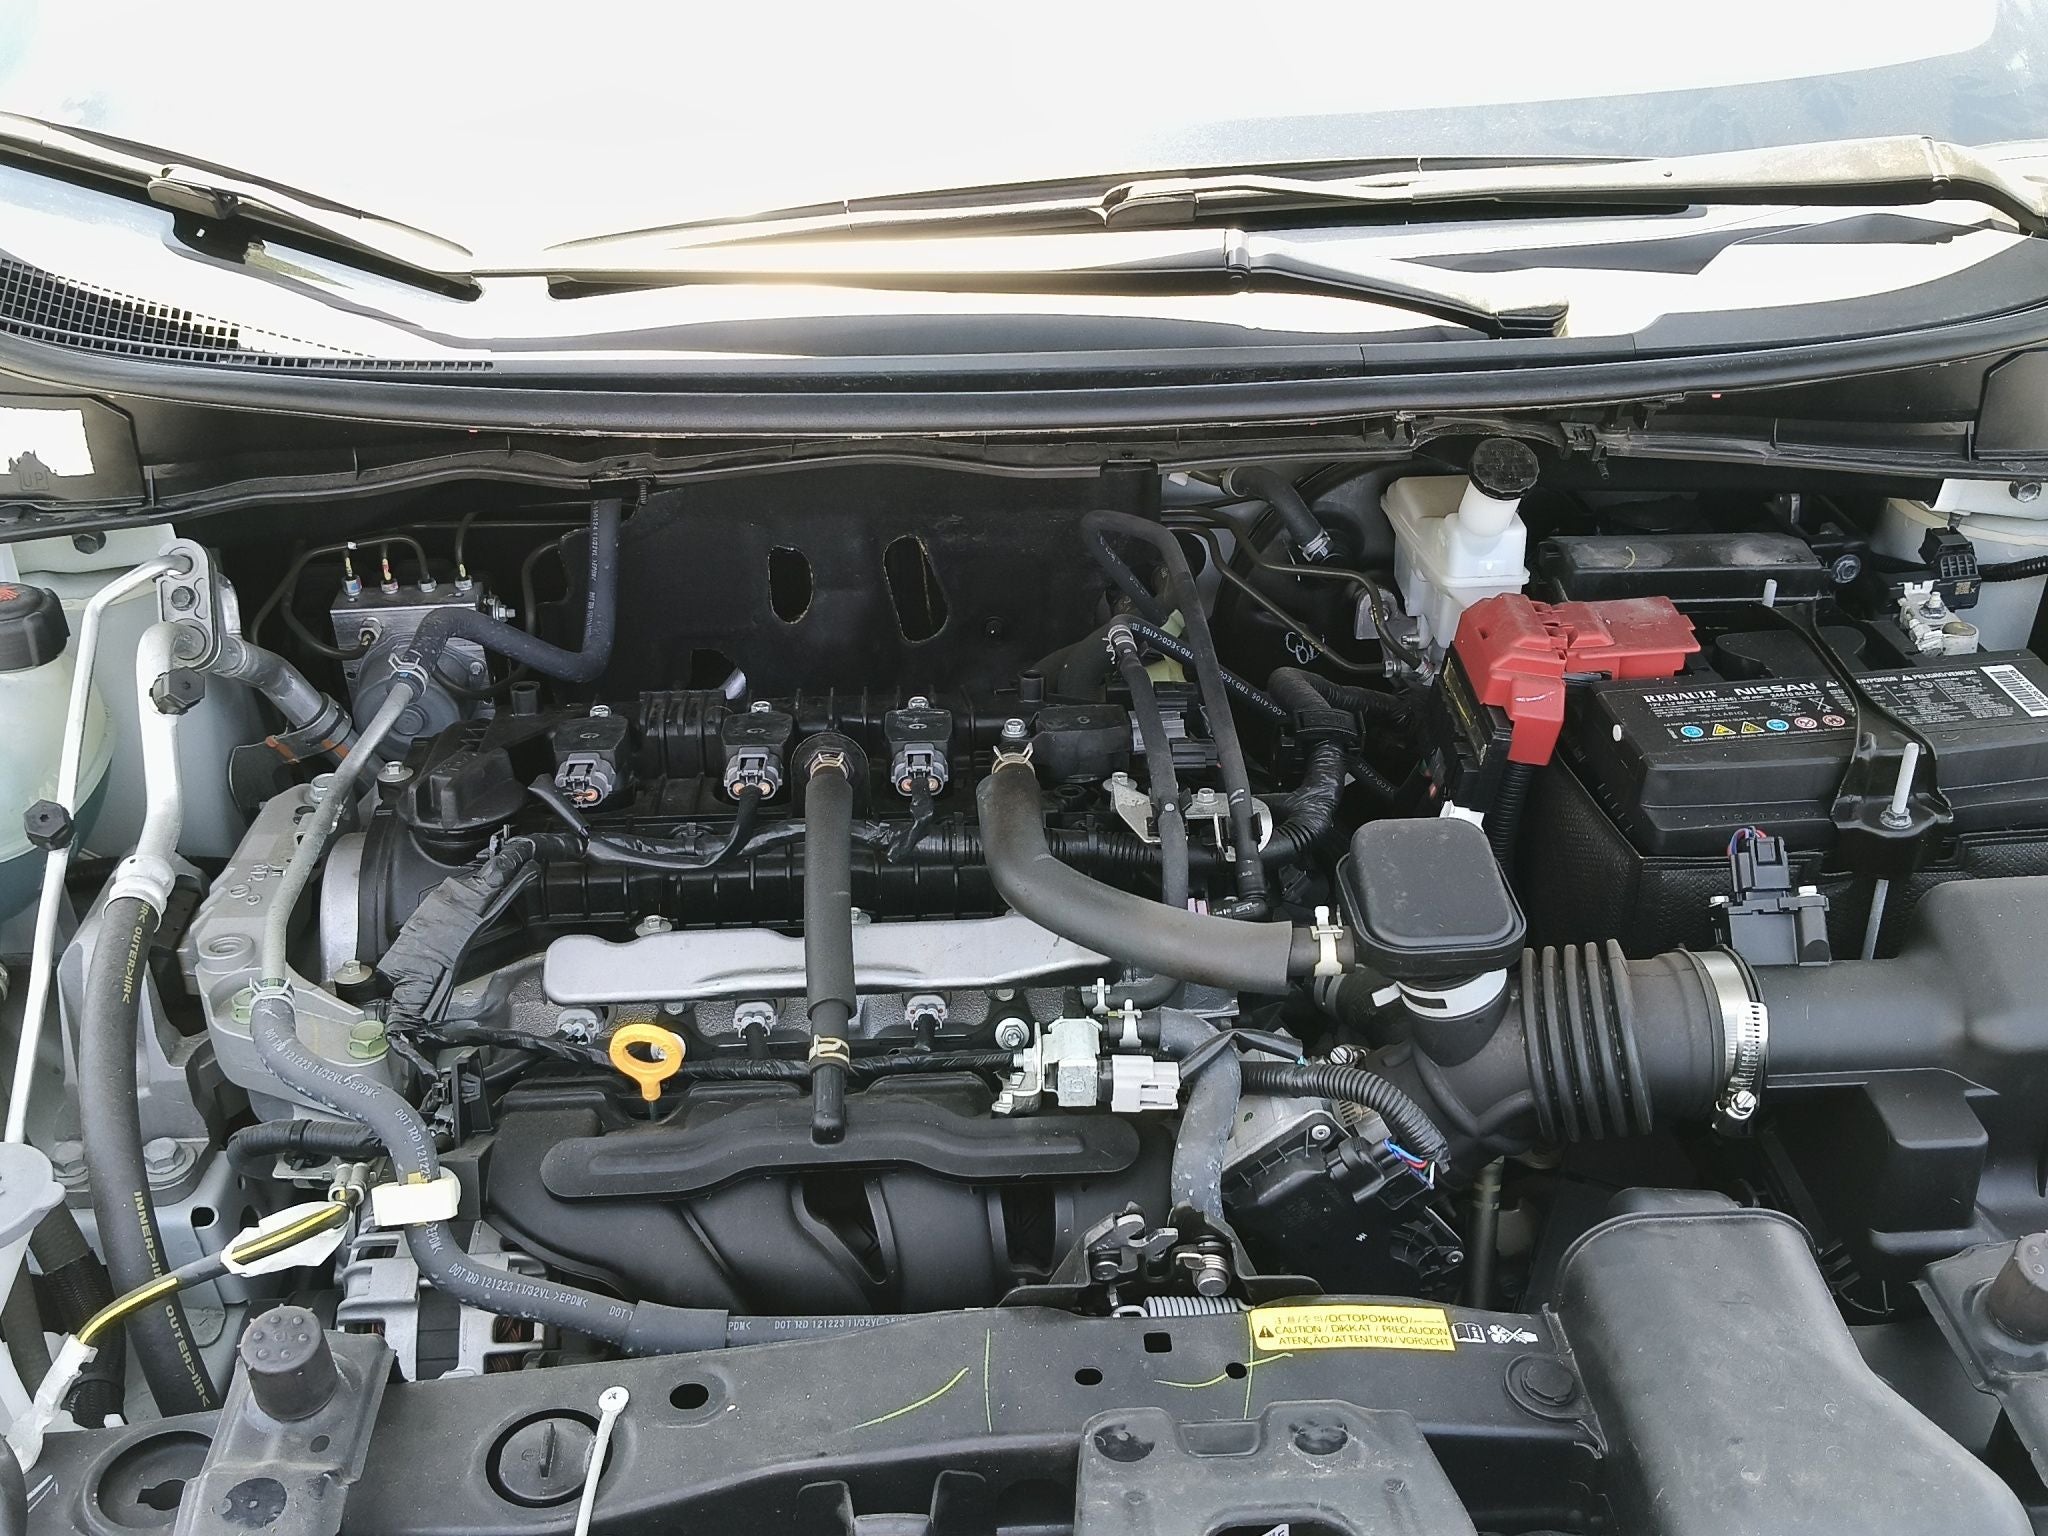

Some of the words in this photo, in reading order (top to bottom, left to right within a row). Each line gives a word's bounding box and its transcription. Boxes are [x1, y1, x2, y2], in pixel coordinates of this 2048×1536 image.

[1733, 682, 1818, 696] NISSAN
[1642, 690, 1717, 703] RENAULT
[447, 1261, 467, 1280] DOT
[480, 1275, 514, 1294] 121223
[608, 1304, 628, 1319] DOT
[727, 1320, 752, 1333] PDM<
[774, 1319, 792, 1331] DOT
[811, 1318, 846, 1330] 121223
[1274, 1325, 1322, 1335] CAUTION
